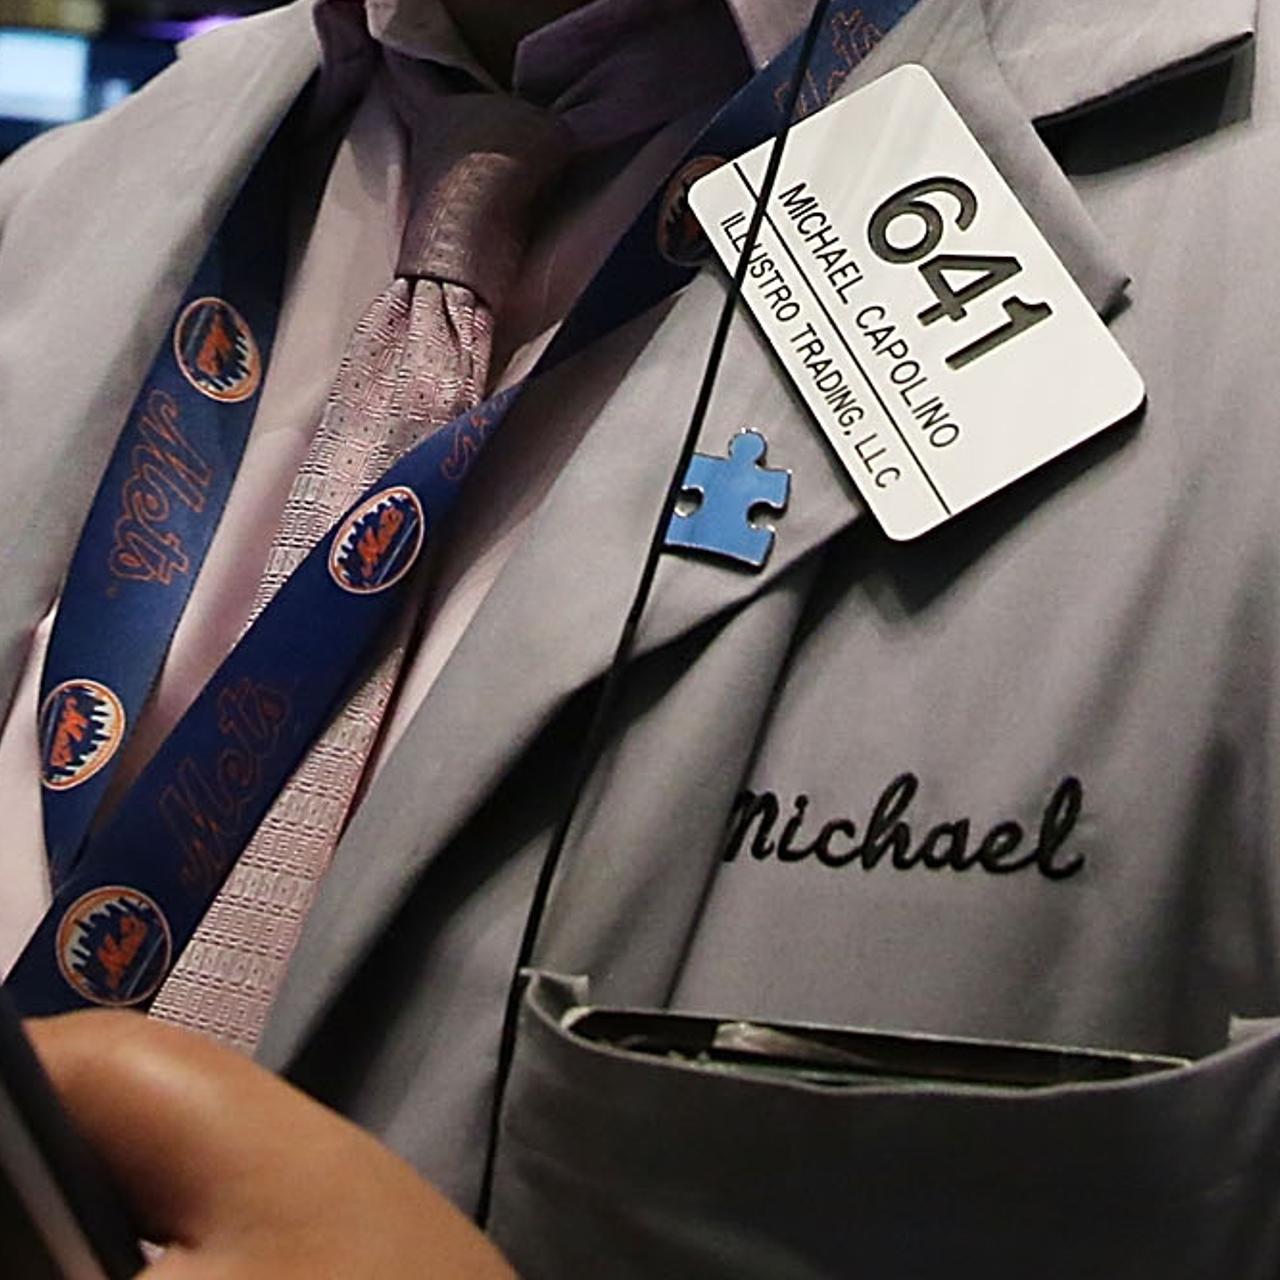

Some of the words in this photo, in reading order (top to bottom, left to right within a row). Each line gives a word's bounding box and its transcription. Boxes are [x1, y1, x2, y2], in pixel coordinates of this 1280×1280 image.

[778, 182, 864, 305] MICHAEL
[867, 176, 1054, 371] 641
[790, 322, 864, 437] TRADING,
[854, 433, 901, 489] LLC
[856, 305, 960, 449] CAPOLINO
